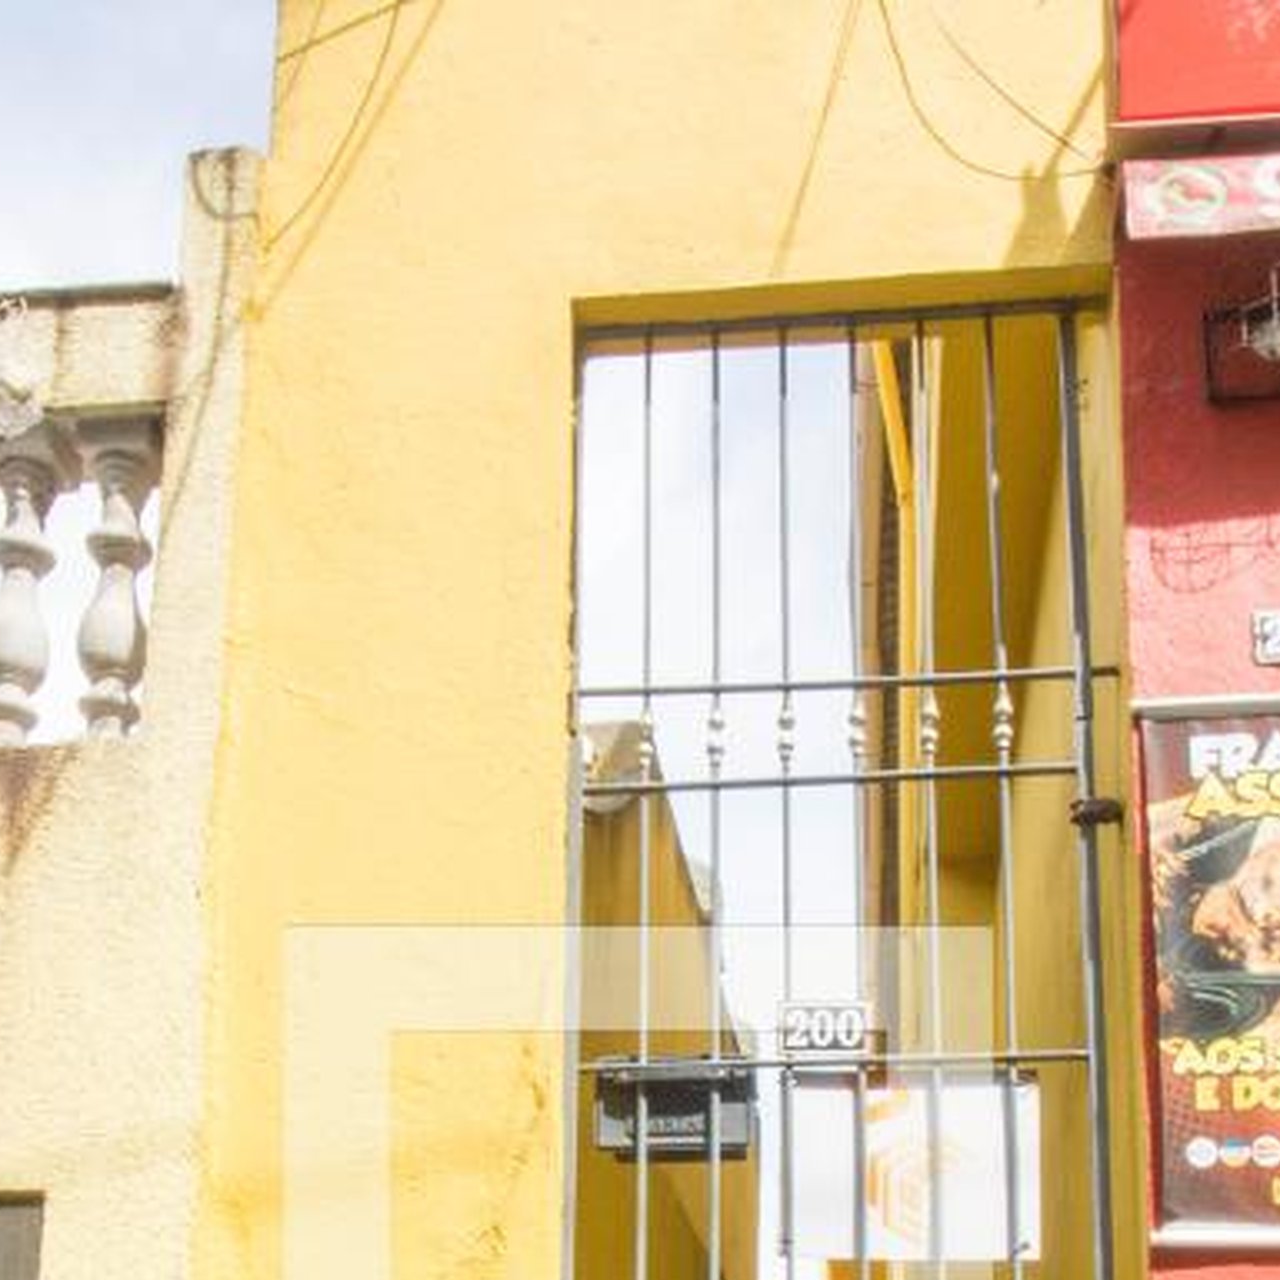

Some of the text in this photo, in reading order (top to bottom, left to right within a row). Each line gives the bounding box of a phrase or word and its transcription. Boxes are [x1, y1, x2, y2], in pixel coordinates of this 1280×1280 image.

[785, 1009, 865, 1048] 200
[1172, 1037, 1265, 1075] AOS
[1195, 1076, 1219, 1111] E
